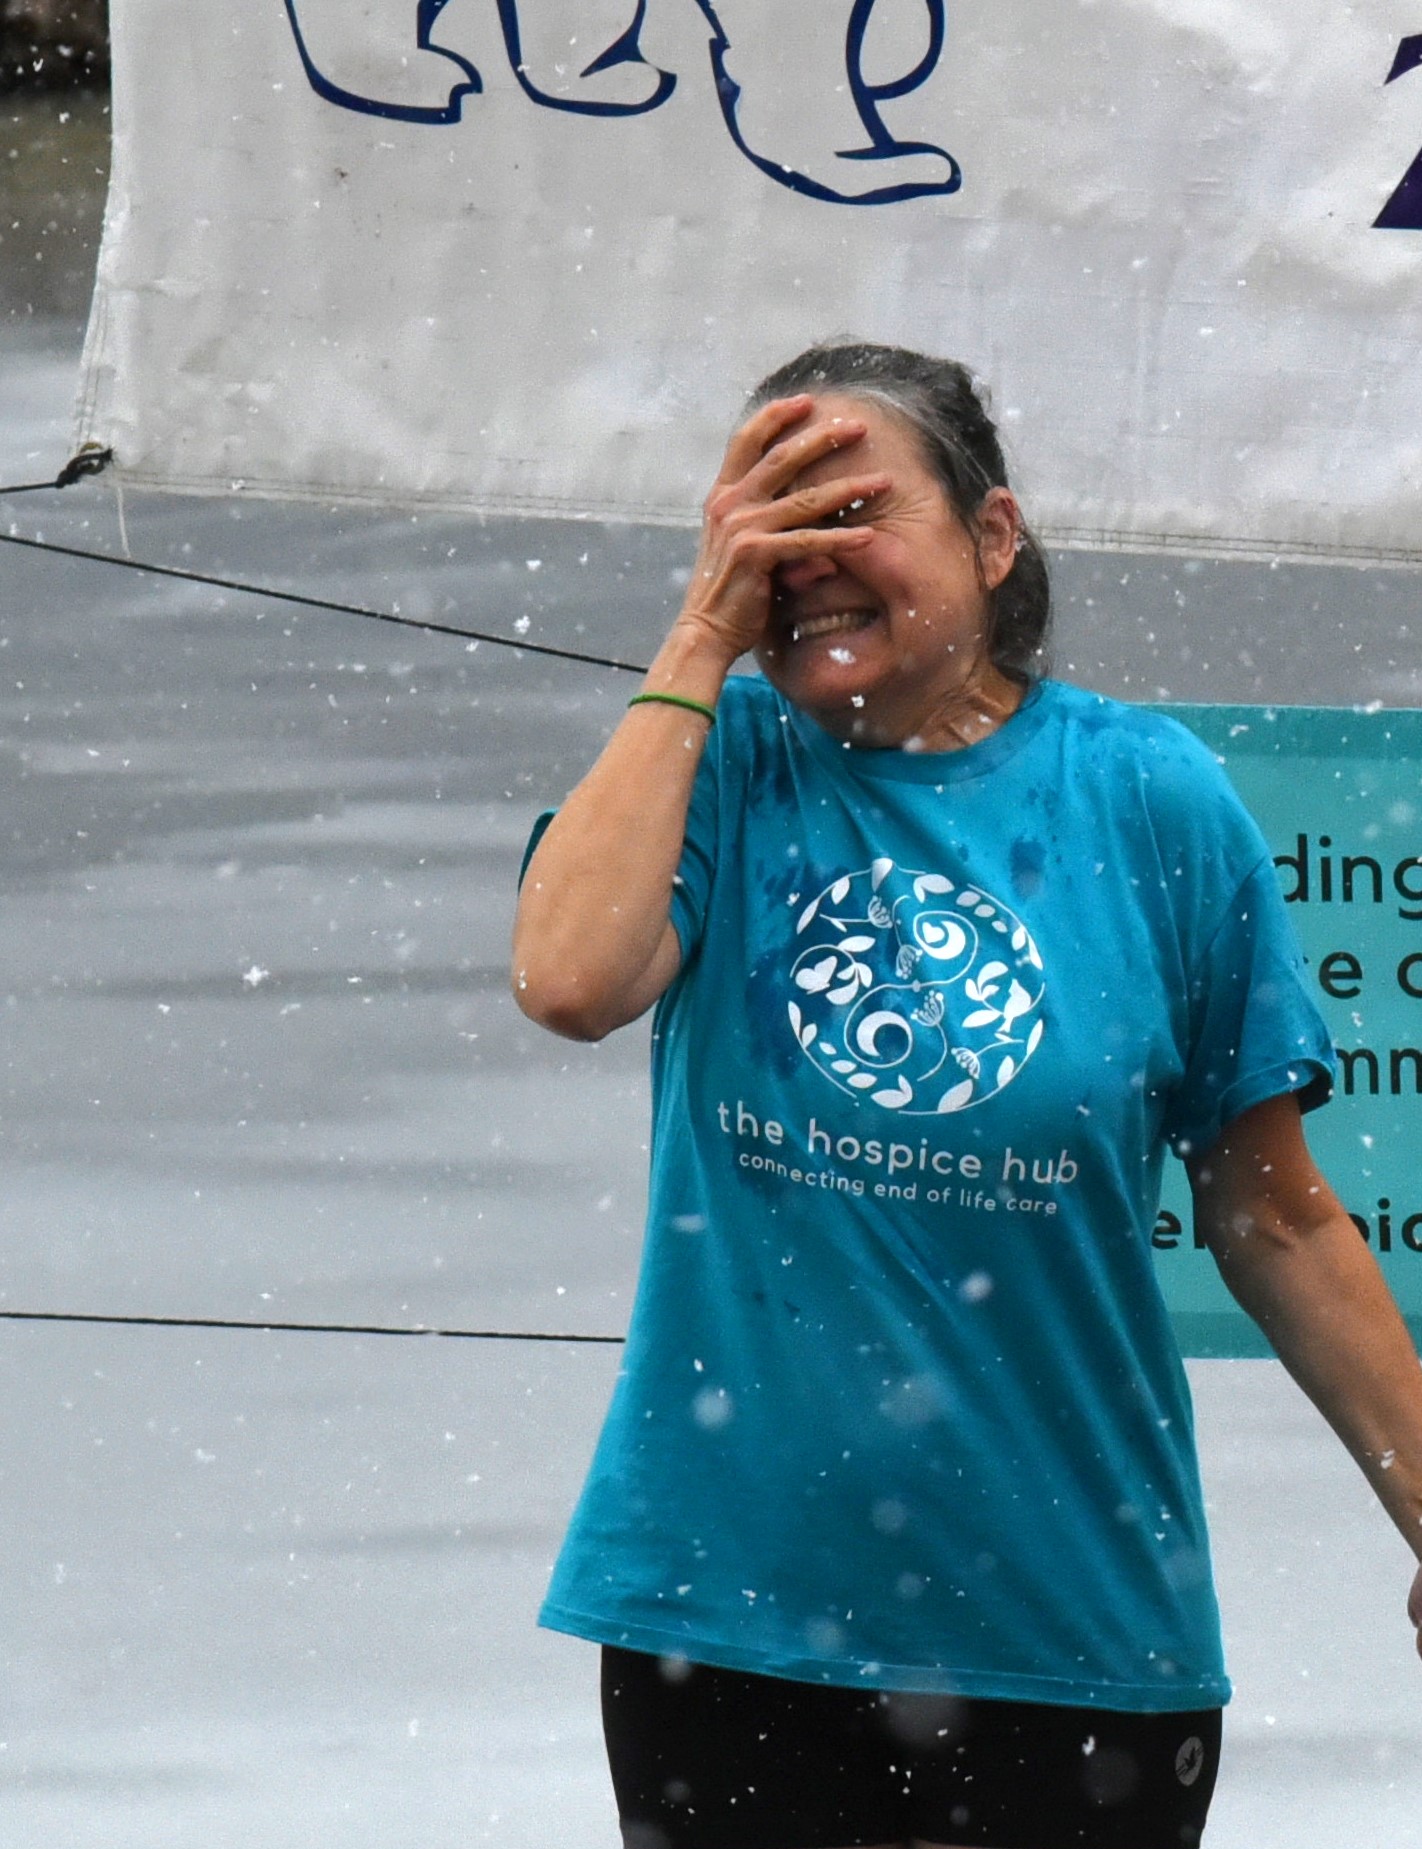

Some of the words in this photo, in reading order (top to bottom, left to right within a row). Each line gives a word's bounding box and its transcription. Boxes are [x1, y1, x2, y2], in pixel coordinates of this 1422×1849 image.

[1303, 952, 1363, 999] e
[717, 1100, 784, 1145] the
[808, 1117, 982, 1176] hospice
[1002, 1147, 1078, 1184] hub
[739, 1152, 865, 1196] connecting
[874, 1182, 917, 1201] end
[926, 1187, 952, 1204] of
[959, 1188, 996, 1211] life
[1006, 1197, 1058, 1215] care
